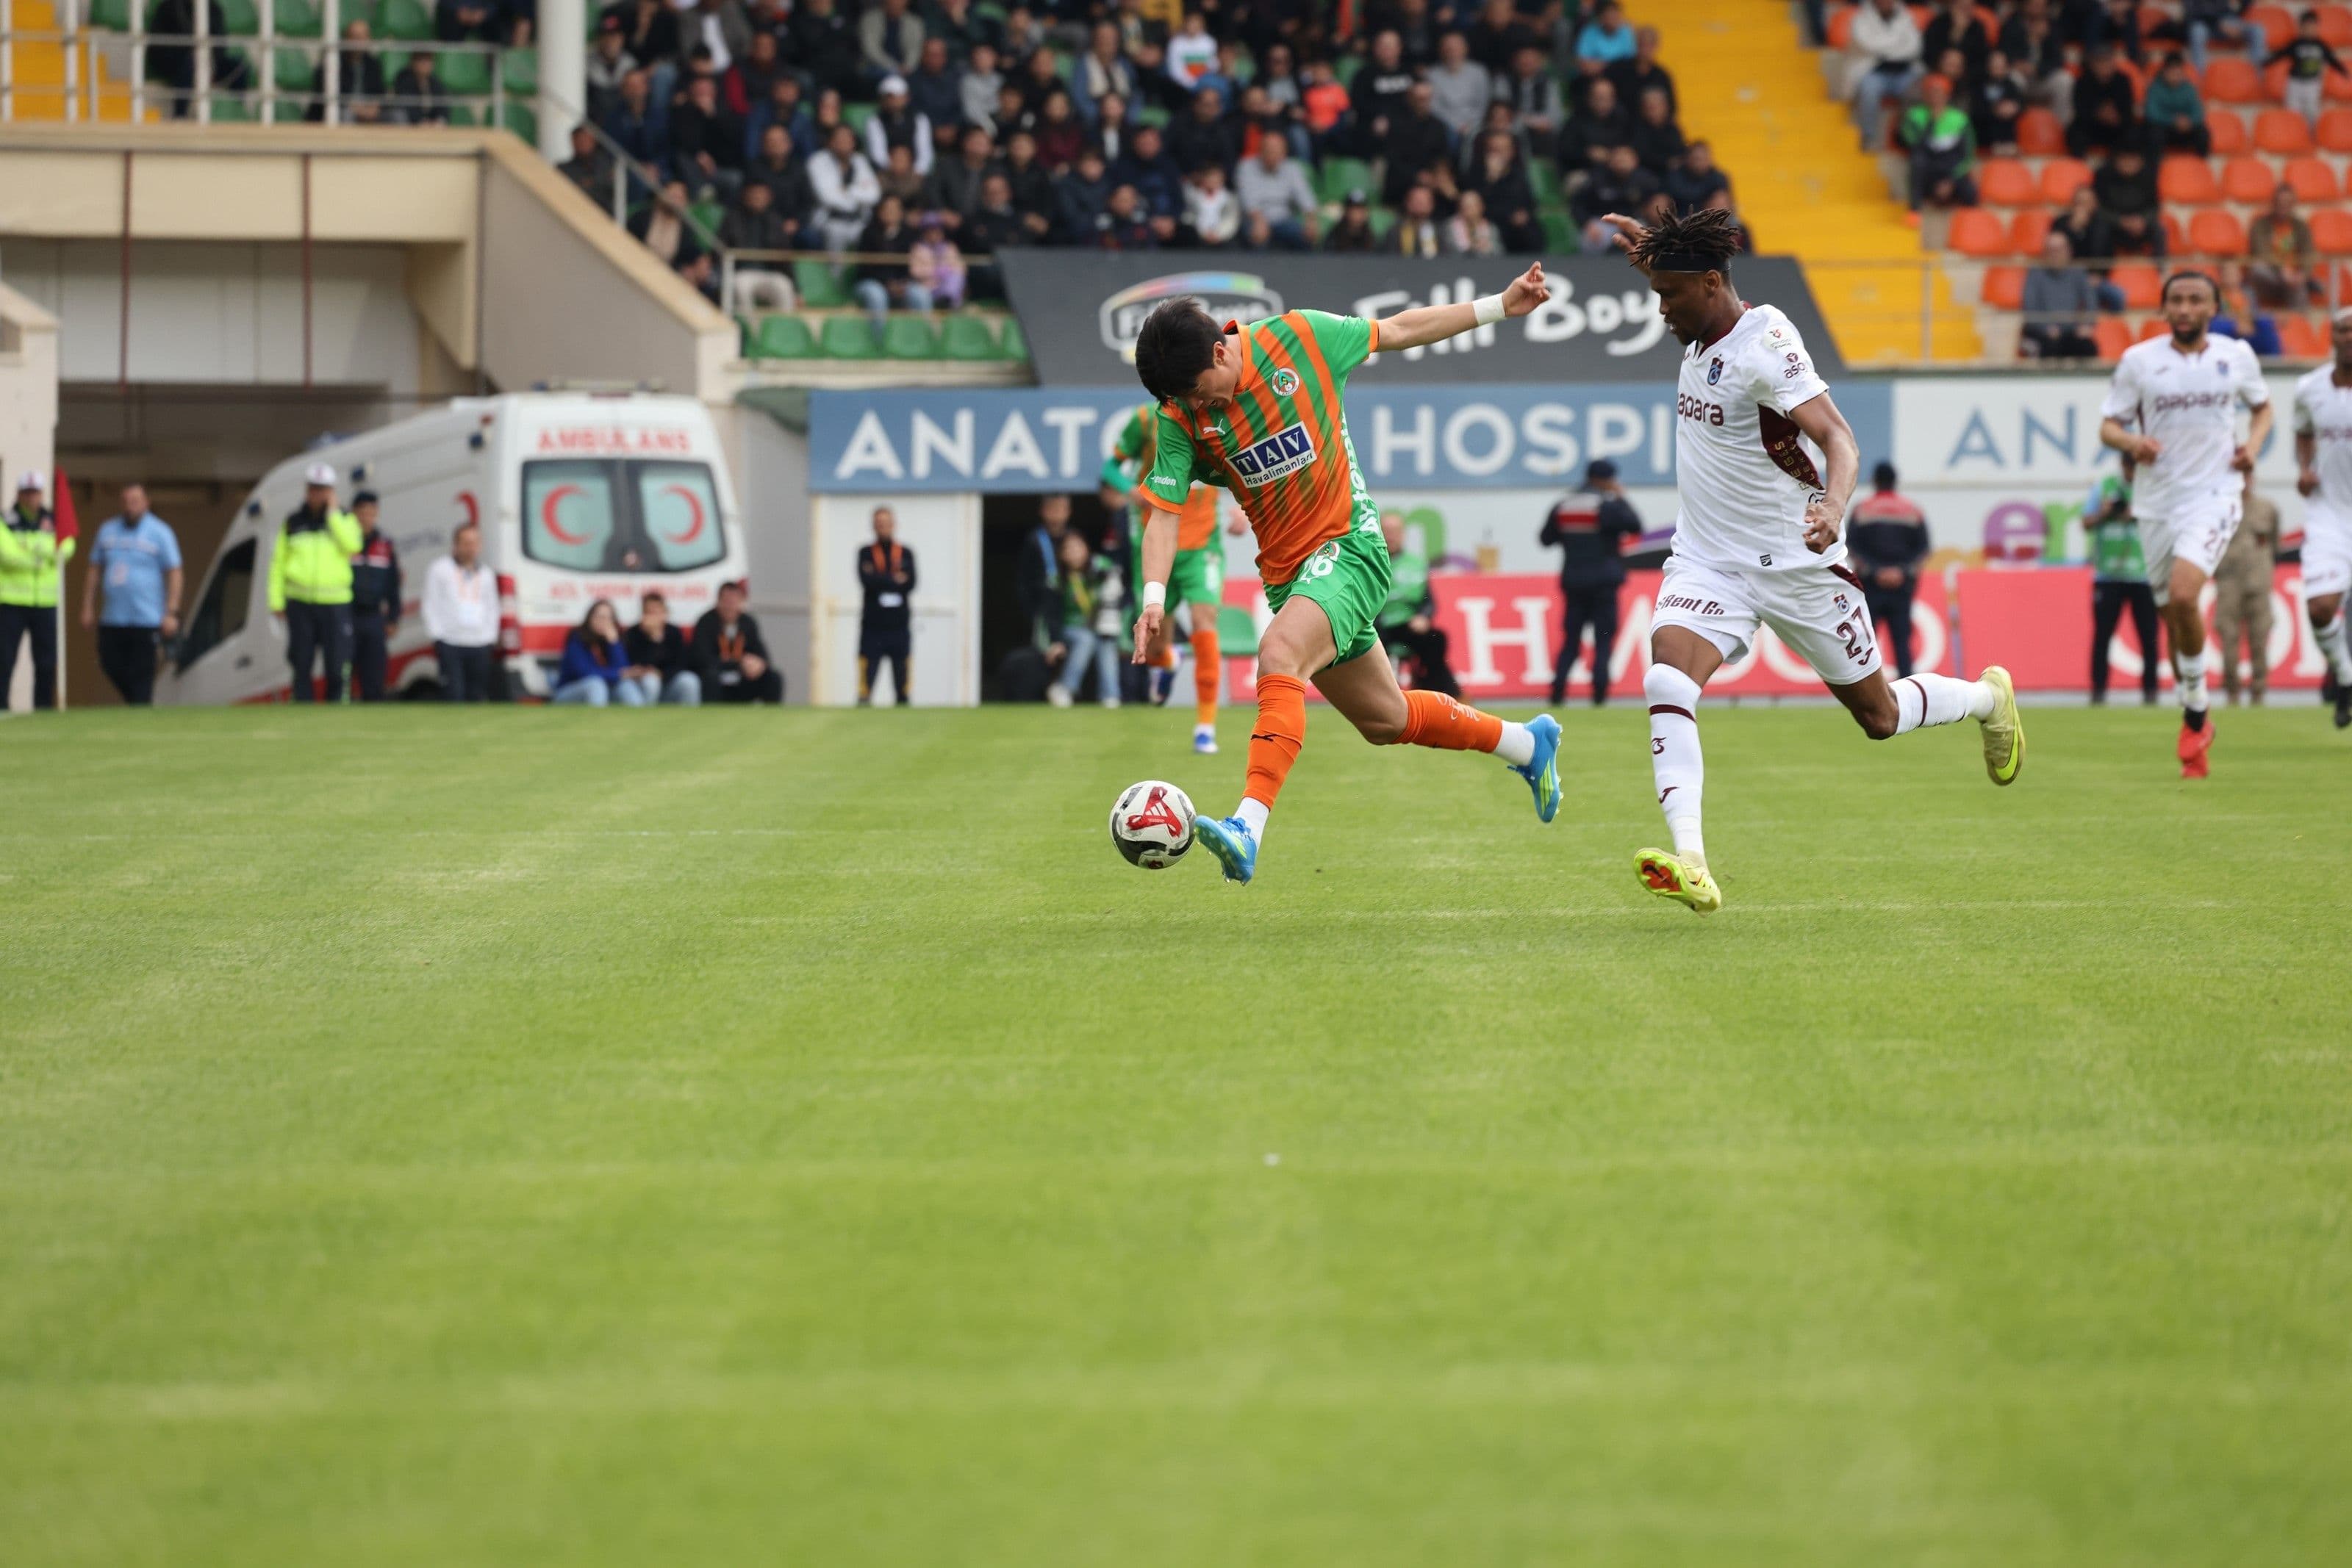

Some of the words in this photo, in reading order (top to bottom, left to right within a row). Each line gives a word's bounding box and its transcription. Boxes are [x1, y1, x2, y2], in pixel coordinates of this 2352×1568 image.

[1524, 272, 1668, 357] Boy
[1678, 393, 1724, 426] apara
[836, 406, 1138, 480] ANATO
[1371, 403, 1673, 477] HOSPI
[1236, 431, 1301, 473] TAV
[1837, 605, 1873, 659] 27
